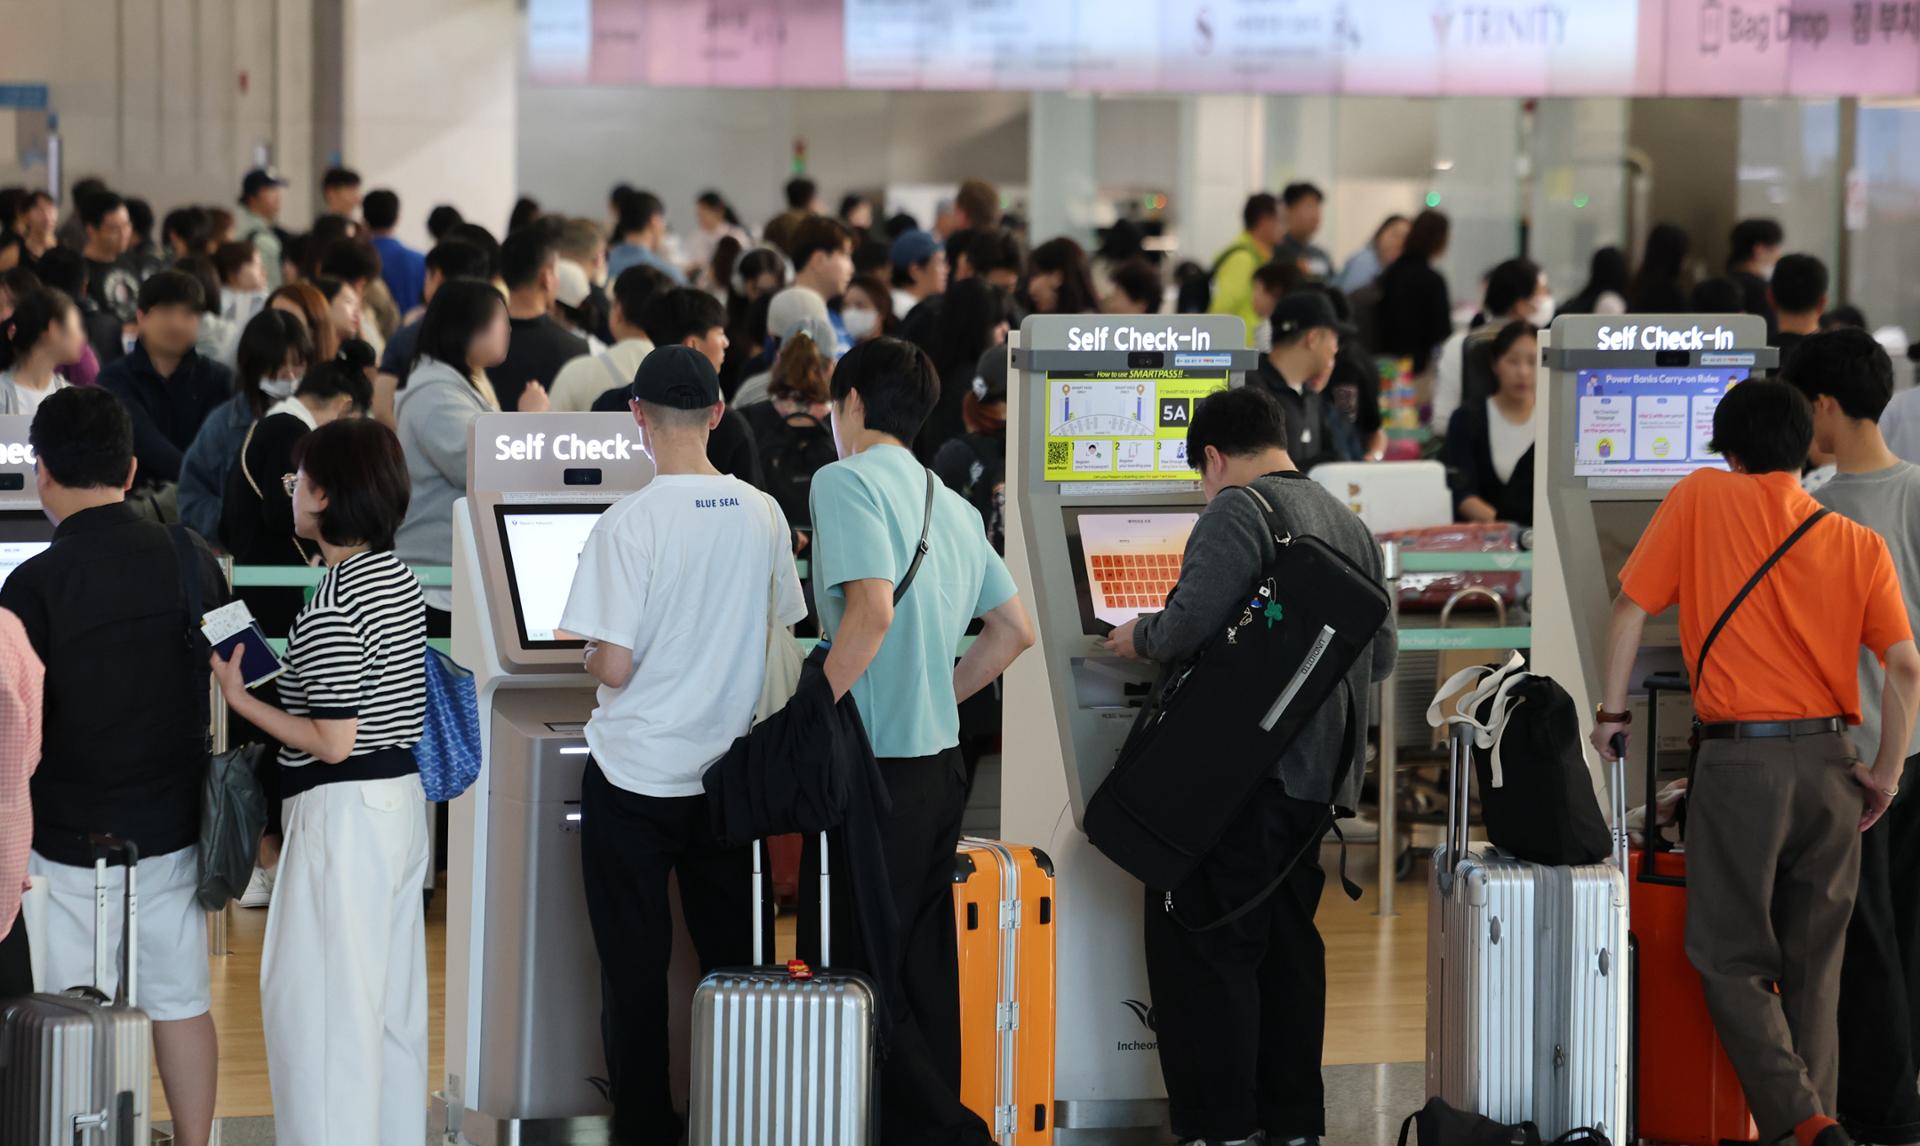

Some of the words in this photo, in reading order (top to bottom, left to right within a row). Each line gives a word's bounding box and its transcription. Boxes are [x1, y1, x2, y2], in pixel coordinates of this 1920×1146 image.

[1728, 7, 1769, 52] Bag
[1776, 8, 1828, 49] Drop
[1068, 327, 1109, 351] Self
[1114, 327, 1210, 351] Check-In
[1597, 325, 1638, 350] Self
[1641, 325, 1734, 350] Check-In
[1097, 370, 1110, 378] How
[1129, 369, 1183, 379] SMARTPASS!!
[1606, 374, 1632, 384] Power
[1633, 374, 1657, 384] Banks
[1659, 374, 1696, 386] Carry-on
[1698, 374, 1720, 383] Rules
[1163, 405, 1187, 421] 5A
[496, 433, 546, 460] Self
[1115, 442, 1120, 450] 2
[1157, 442, 1162, 450] 3
[696, 499, 716, 508] BLUE
[719, 498, 740, 507] SEAL
